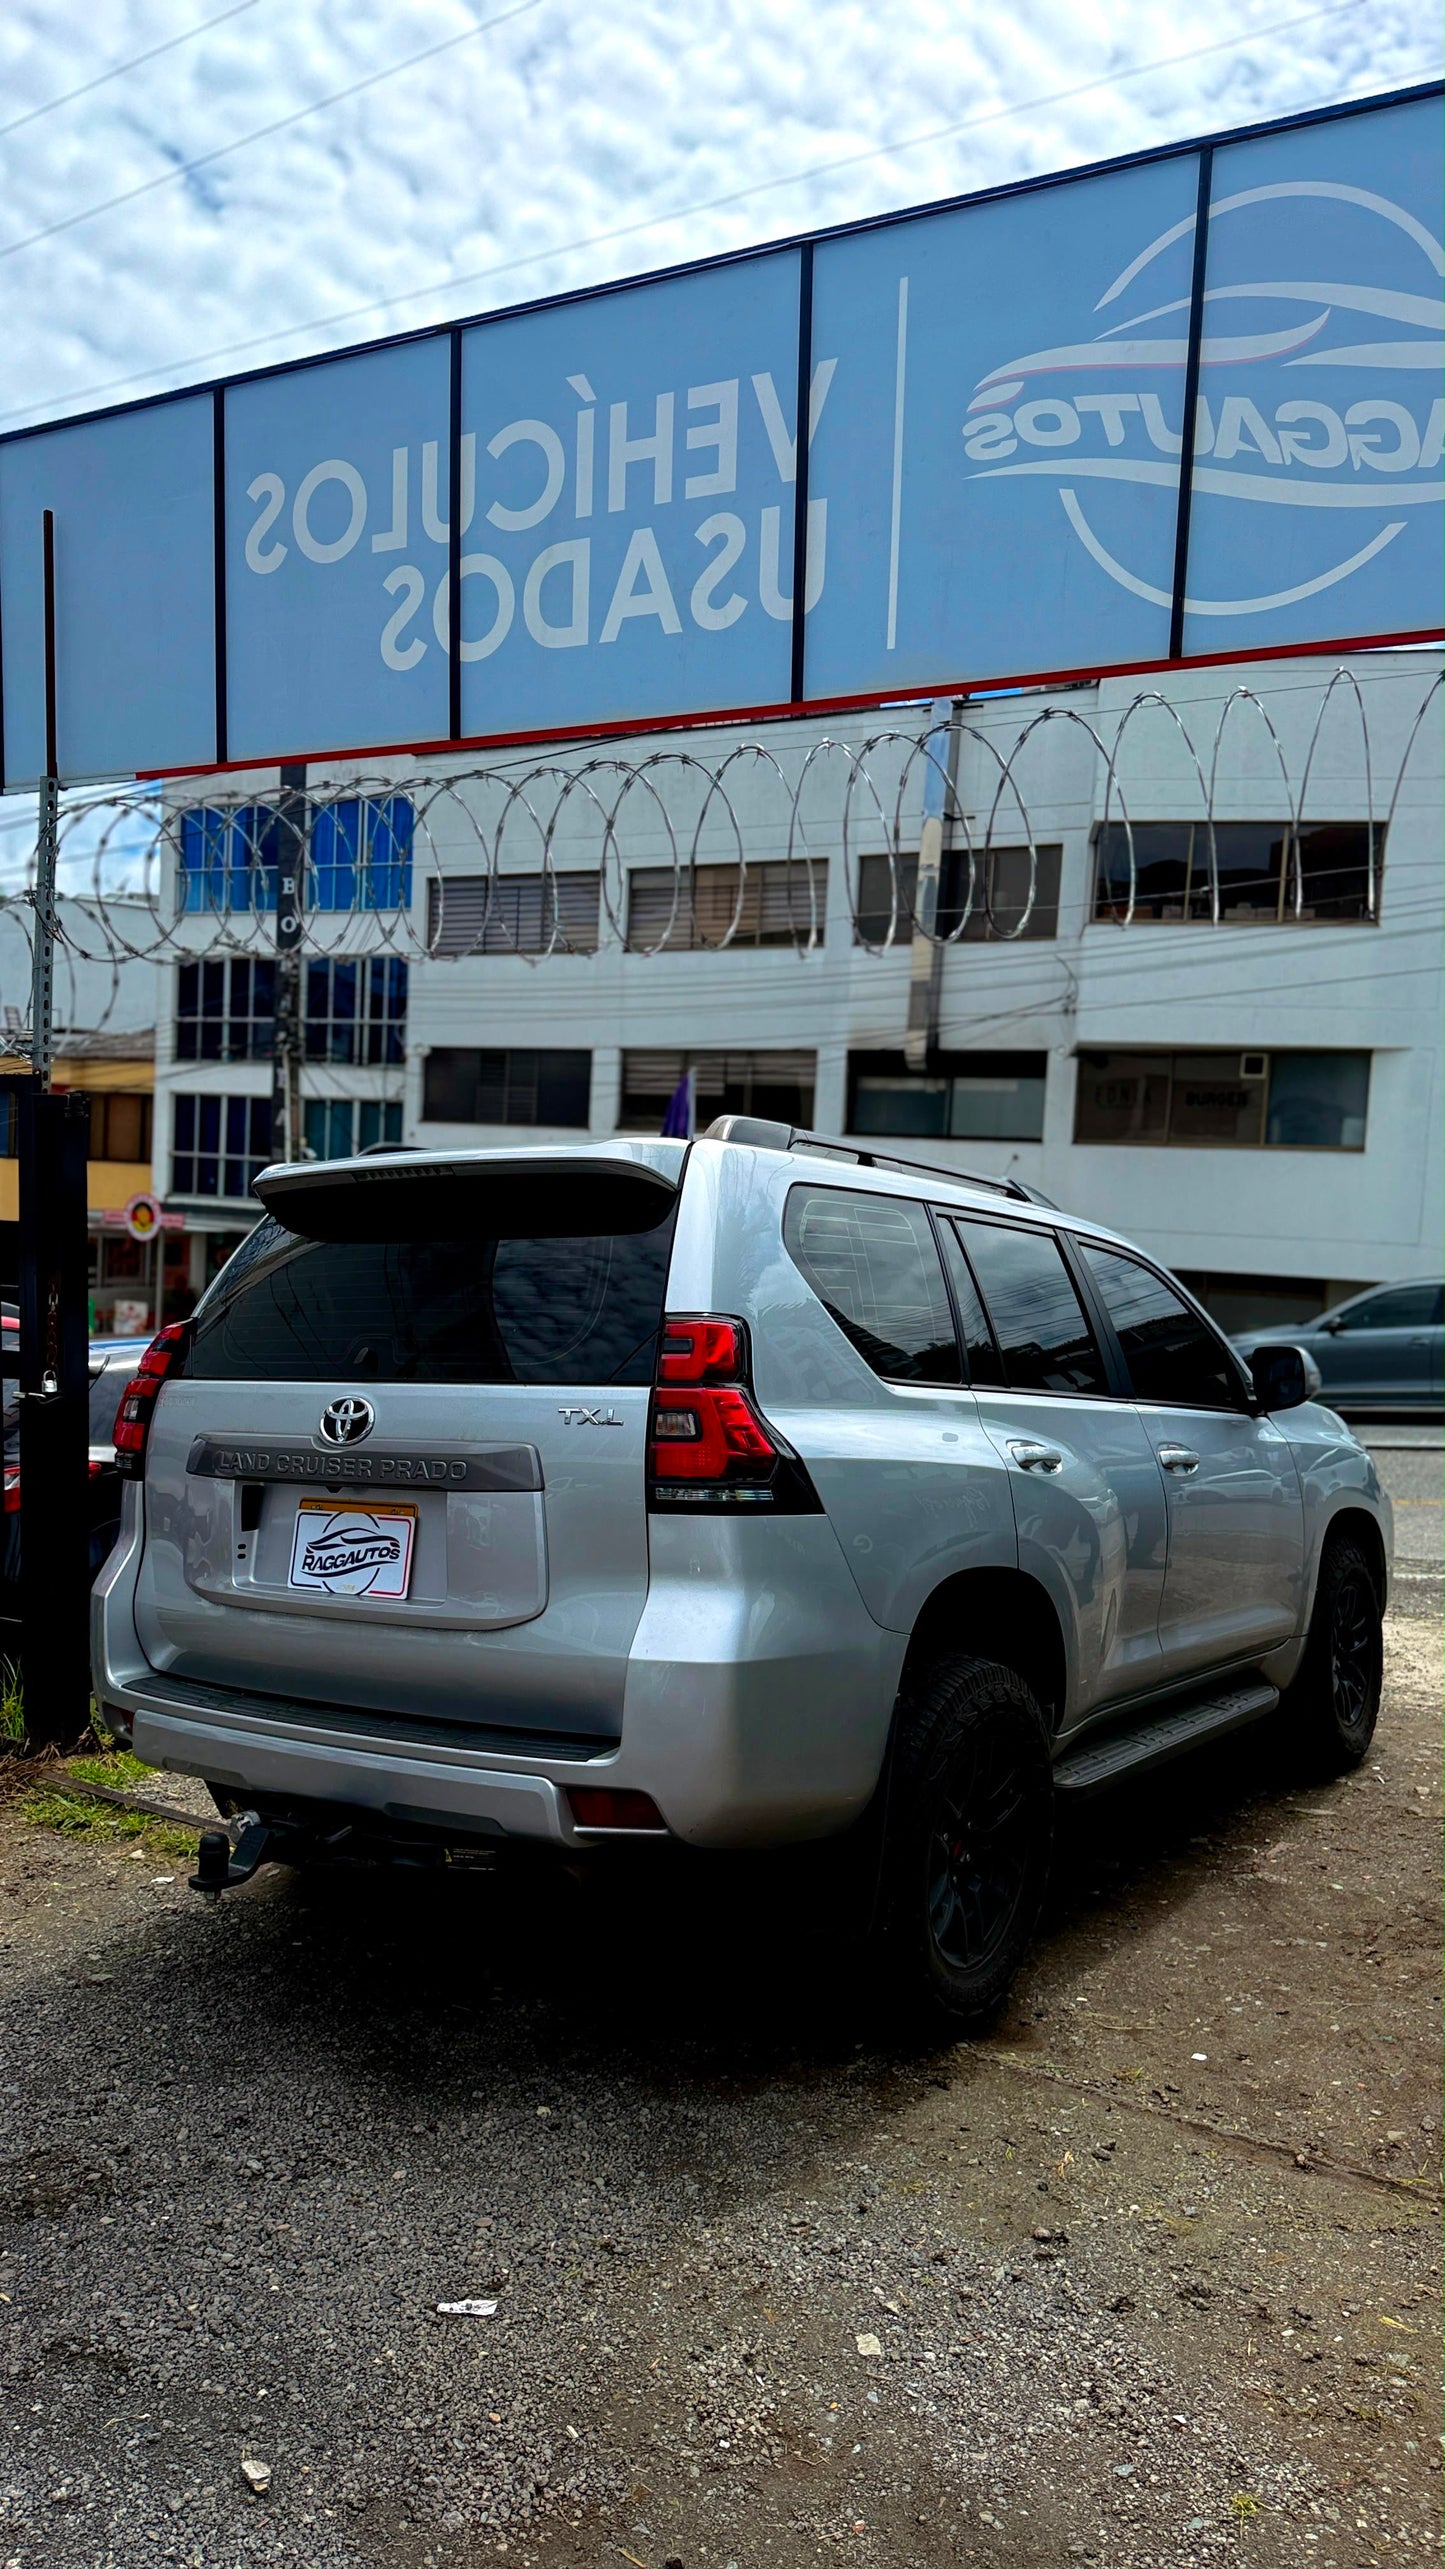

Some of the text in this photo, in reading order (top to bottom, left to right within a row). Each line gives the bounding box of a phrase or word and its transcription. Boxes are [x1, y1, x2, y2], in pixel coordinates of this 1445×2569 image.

[218, 1452, 467, 1481] LAND CRUISER PRADO
[302, 1546, 400, 1571] RAGGAUTOS
